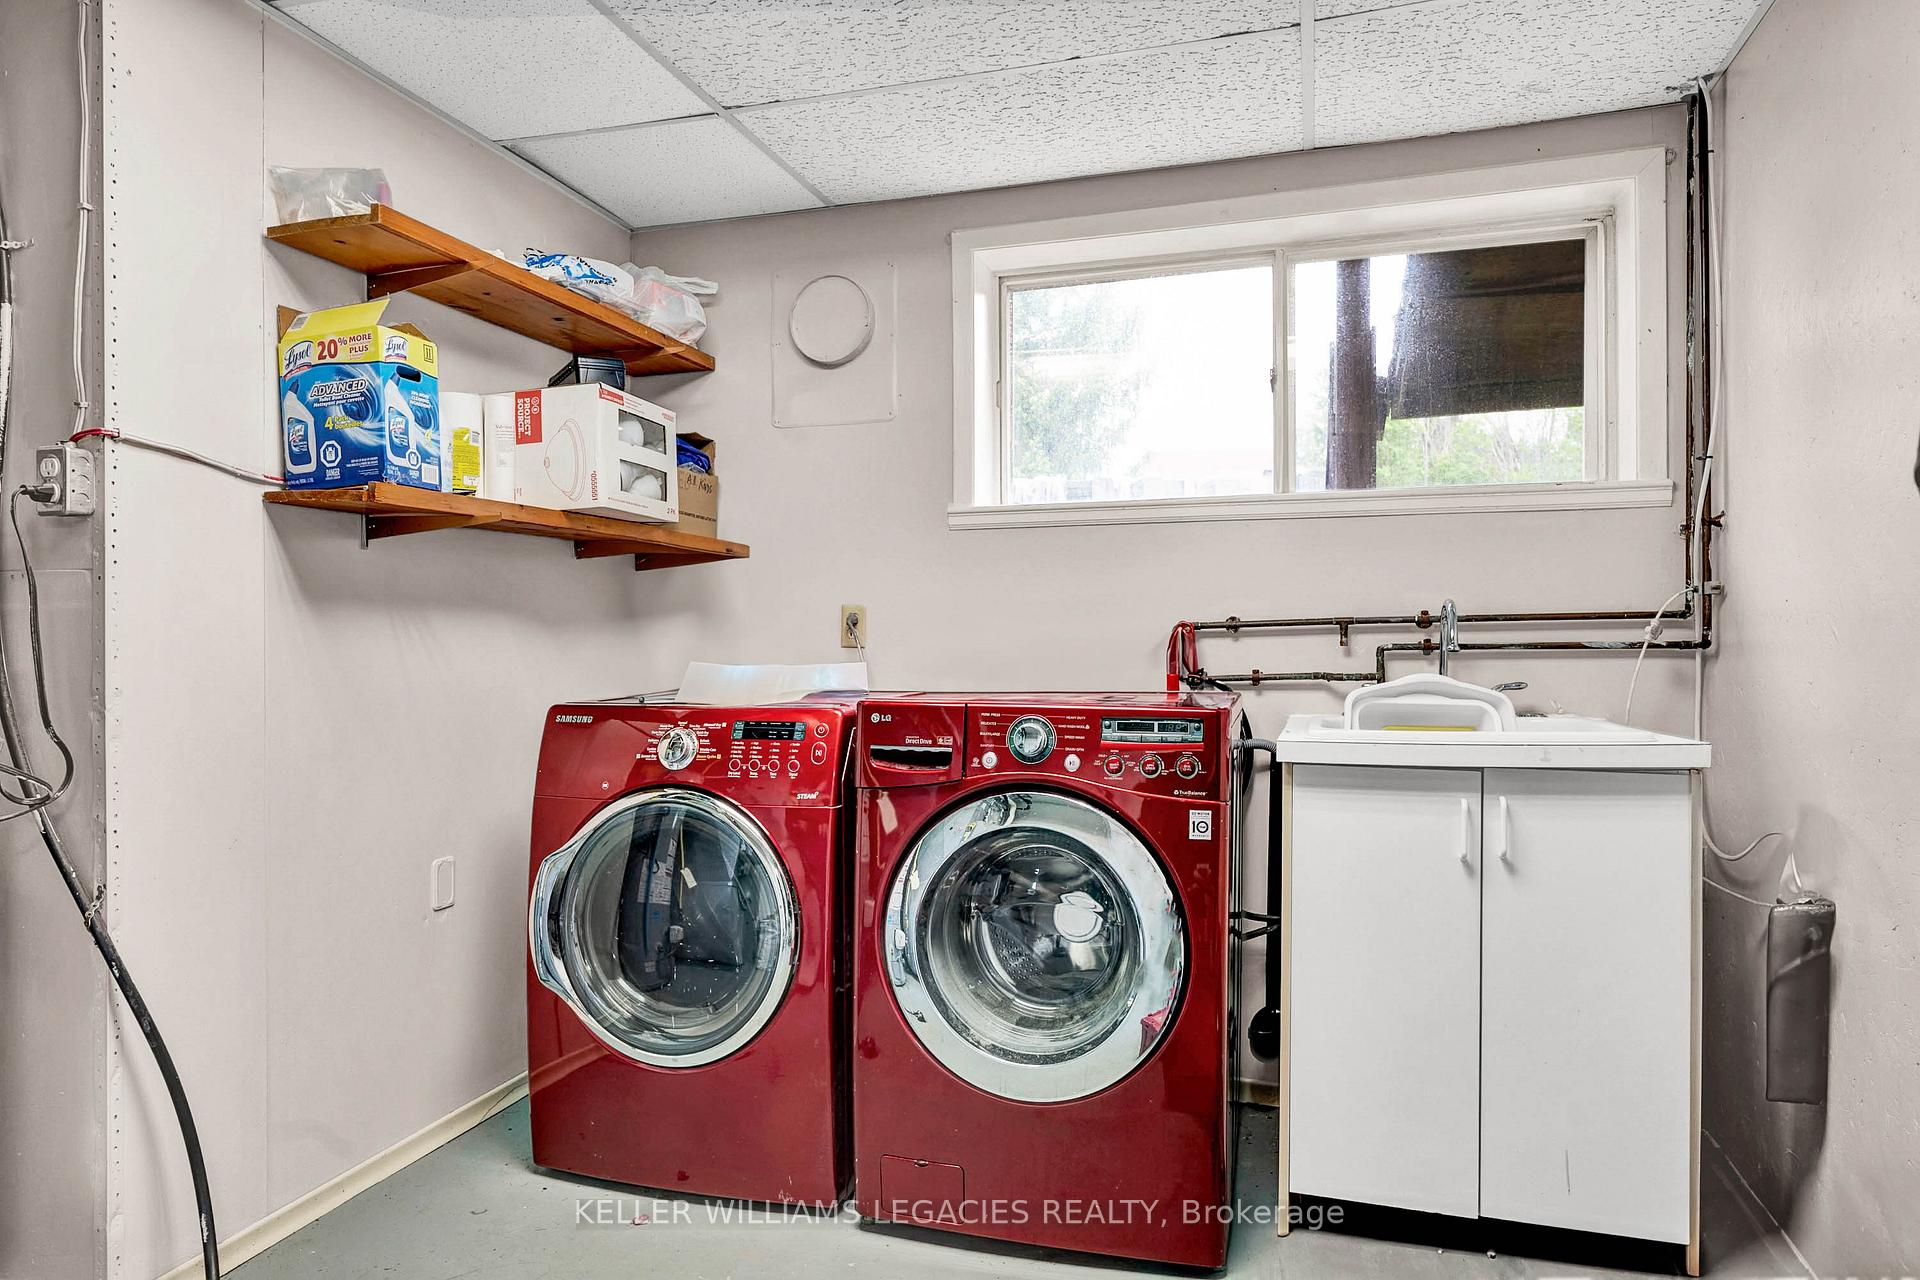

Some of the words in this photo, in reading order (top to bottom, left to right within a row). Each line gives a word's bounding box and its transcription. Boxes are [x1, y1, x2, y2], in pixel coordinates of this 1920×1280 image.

[348, 333, 372, 343] MORE
[349, 344, 369, 354] PLUS
[385, 339, 405, 353] Lysol
[284, 343, 312, 370] Lysol
[310, 379, 367, 398] ADVANCED
[517, 398, 525, 433] SOURCE
[523, 397, 532, 436] PROJECT
[325, 416, 333, 430] 4
[555, 714, 593, 723] SAMSUNG
[881, 714, 892, 722] LG
[796, 791, 819, 800] STEAM
[1192, 820, 1209, 834] 10
